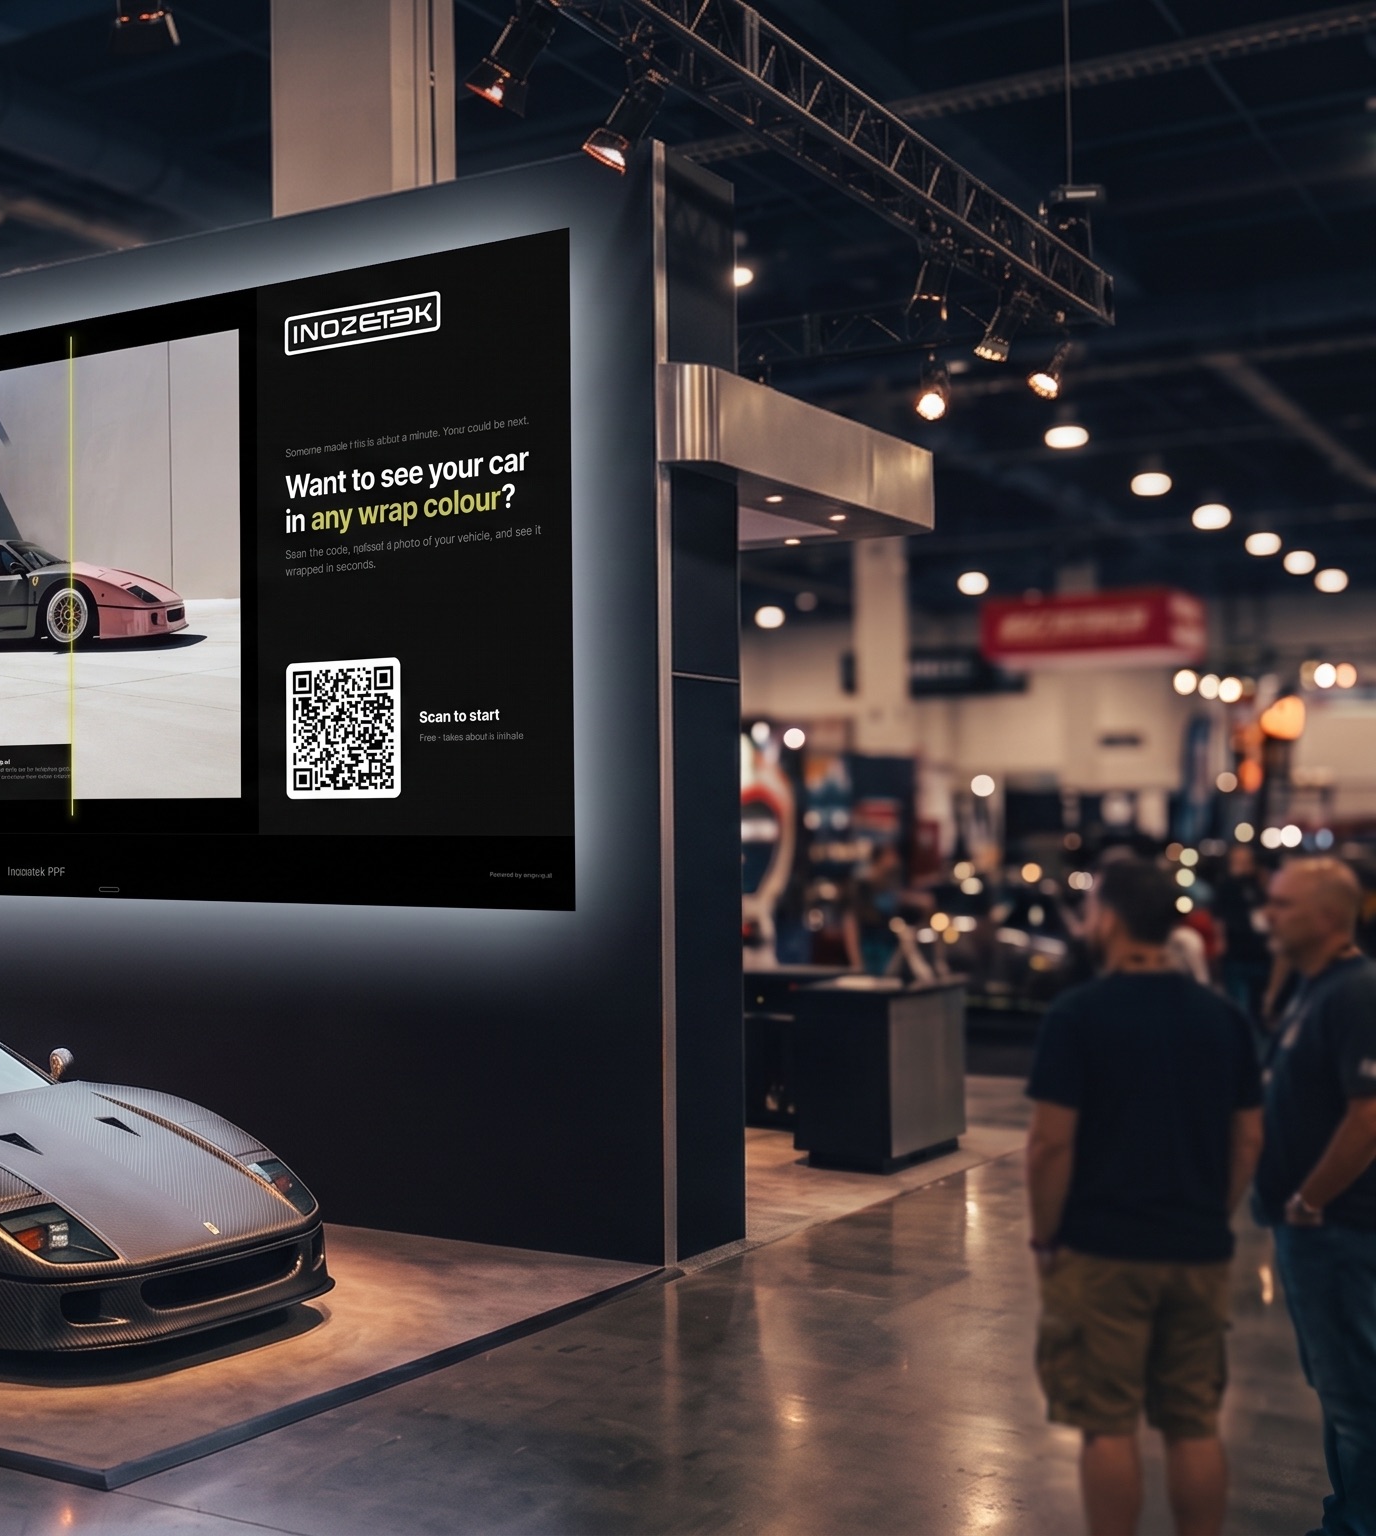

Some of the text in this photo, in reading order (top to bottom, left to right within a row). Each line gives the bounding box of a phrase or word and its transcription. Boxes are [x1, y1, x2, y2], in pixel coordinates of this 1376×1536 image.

[401, 434, 408, 442] a
[409, 429, 441, 441] minute.
[493, 419, 506, 430] be
[507, 415, 530, 428] next.
[285, 451, 529, 499] Want to see your car
[286, 483, 515, 534] in any wrap colour?
[309, 547, 324, 558] the
[325, 544, 351, 556] code,
[393, 538, 421, 552] photo
[422, 535, 433, 547] of
[434, 535, 456, 548] your
[495, 527, 513, 540] and
[515, 527, 533, 537] see
[534, 524, 542, 535] it
[285, 559, 377, 578] wrapped in seconds.
[419, 708, 500, 724] Scan to start
[419, 733, 437, 742] Free
[442, 732, 464, 742] takes
[464, 732, 488, 742] about
[47, 866, 66, 877] PPF
